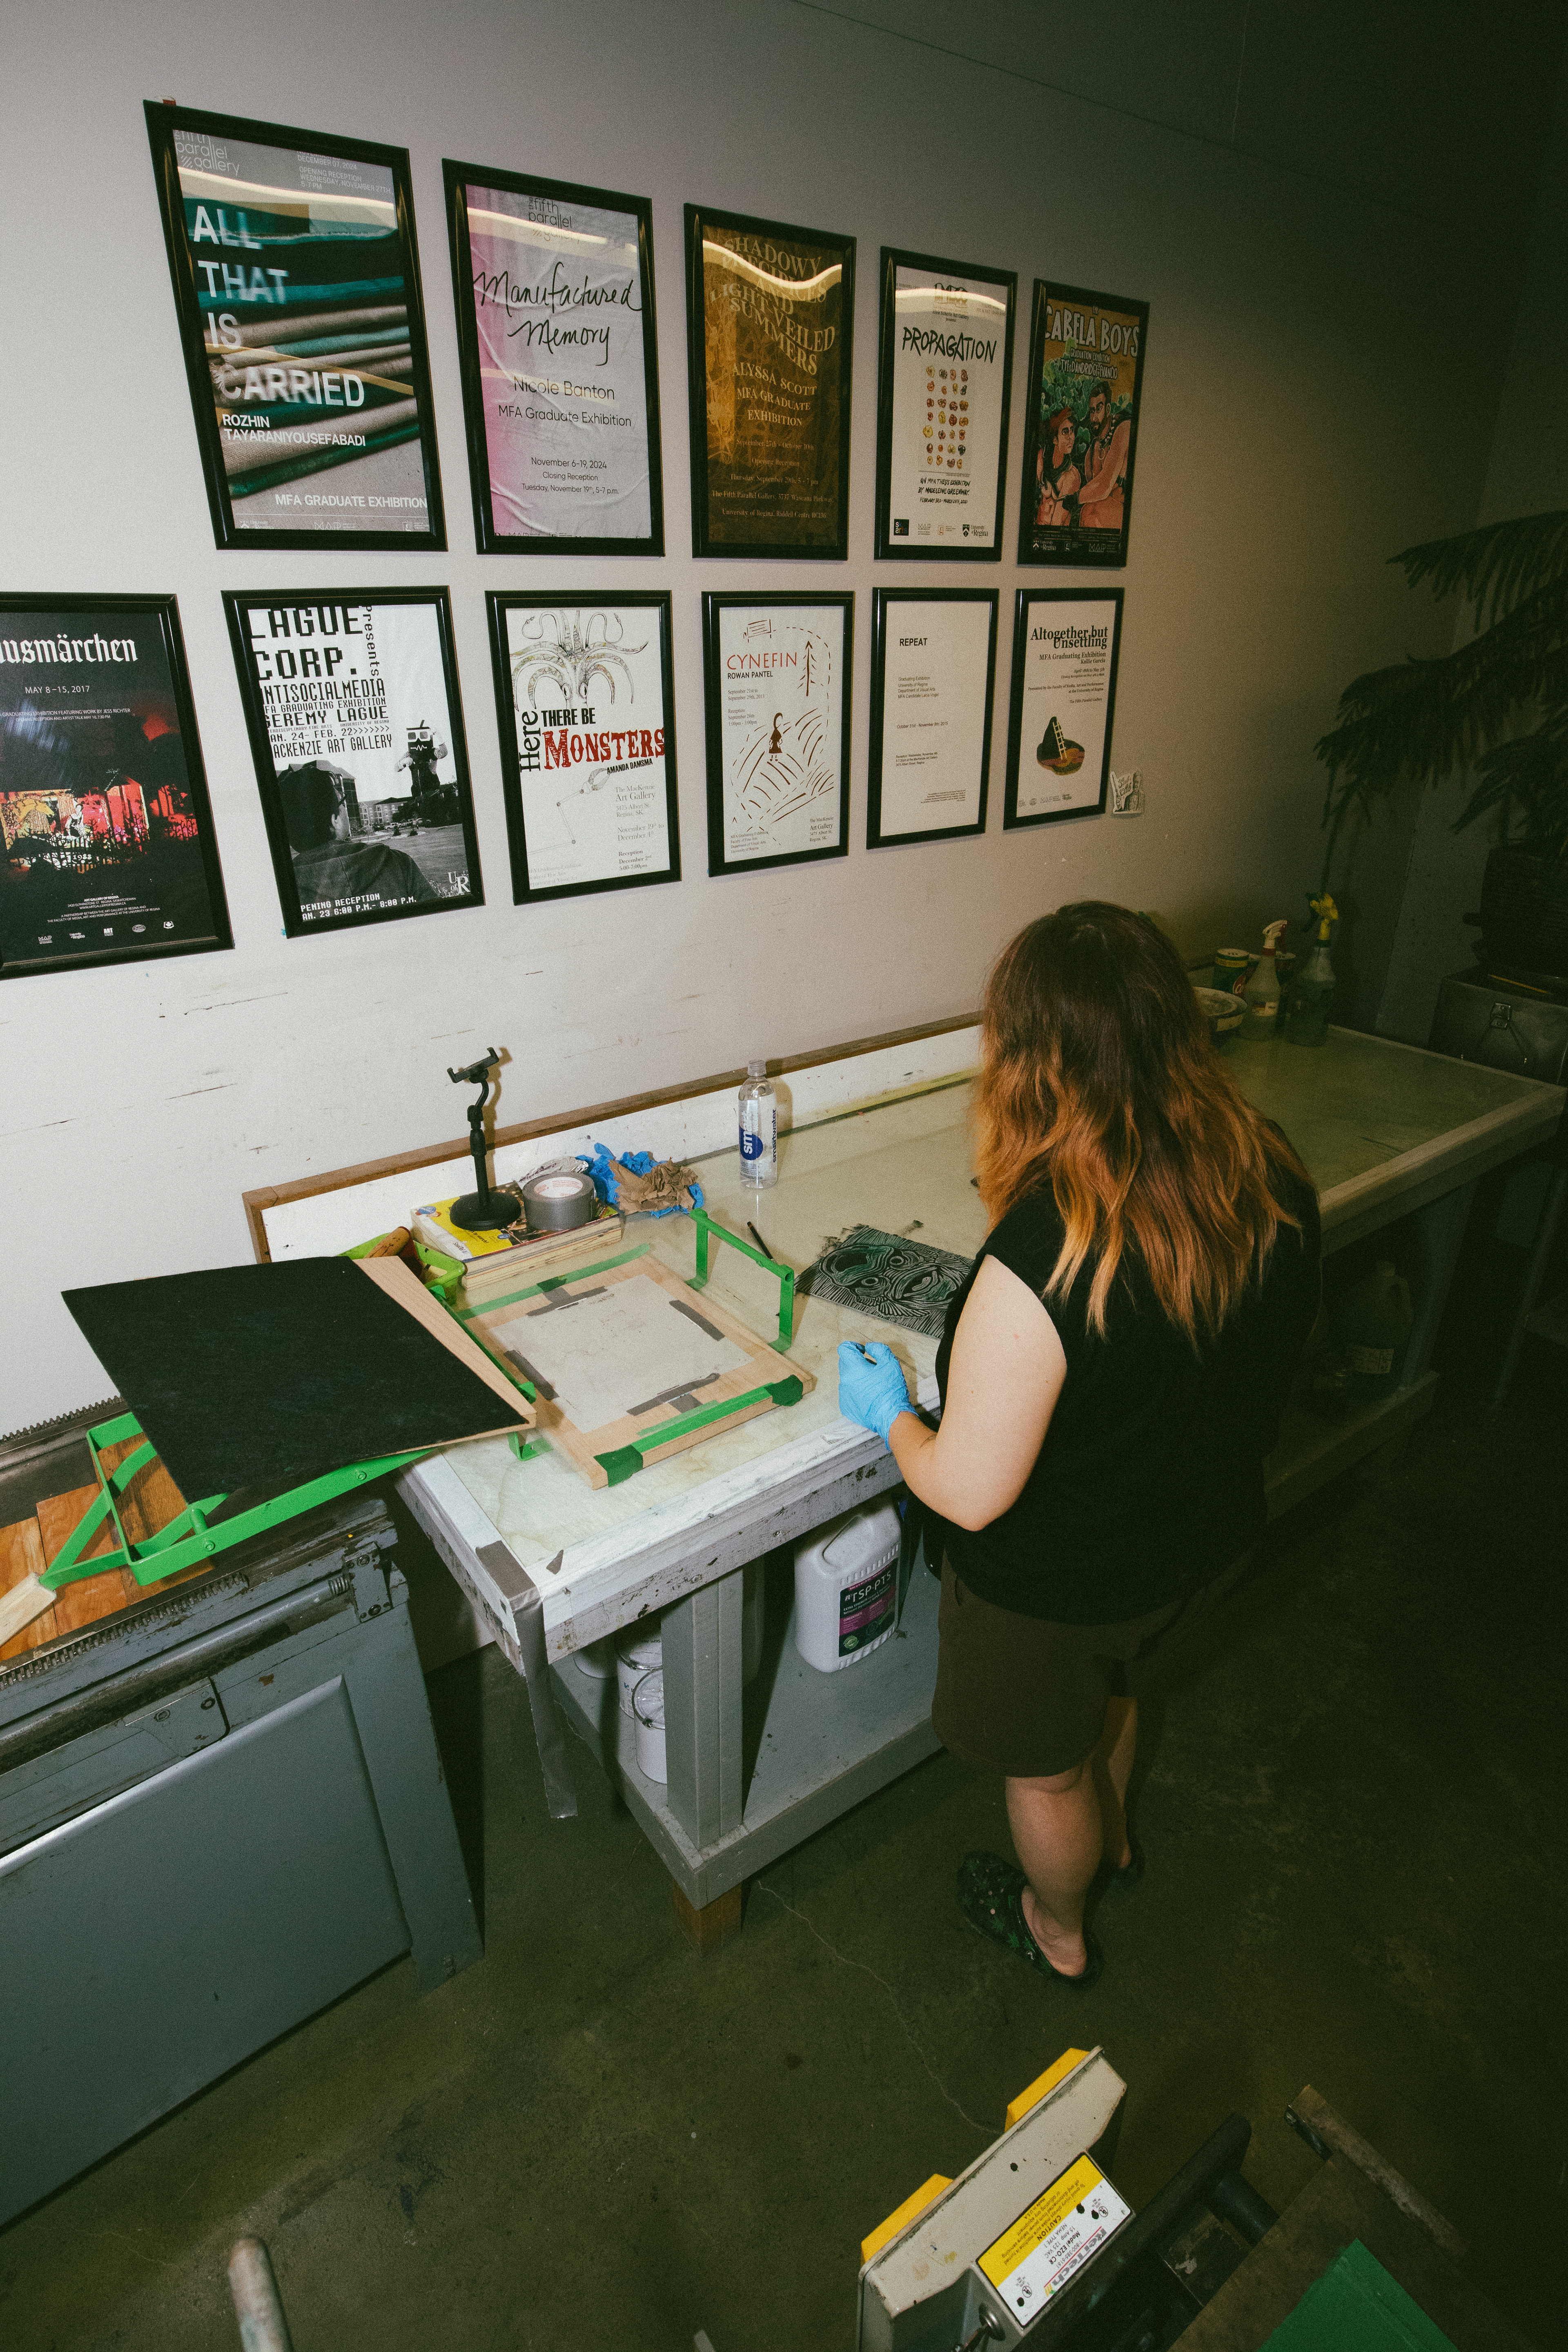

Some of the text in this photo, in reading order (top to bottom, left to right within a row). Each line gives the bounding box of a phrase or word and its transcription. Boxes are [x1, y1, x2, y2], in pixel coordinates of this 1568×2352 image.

[176, 142, 227, 159] parallel
[298, 155, 332, 166] DECEMBER
[299, 166, 362, 182] OPENING RECEPTION
[341, 180, 374, 191] NOVEMBER
[534, 198, 559, 213] fifth
[194, 205, 263, 249] ALL
[528, 212, 572, 228] parallel
[724, 237, 822, 278] SHADOWY
[198, 261, 288, 304] THAT
[474, 261, 642, 317] Manufactured
[710, 283, 835, 352] LIGHT VEILED
[208, 312, 241, 350] IS
[730, 298, 817, 375] SUMMERS
[1100, 318, 1139, 358] BOYS
[507, 319, 610, 366] Memory
[902, 326, 997, 363] PROPAGATION
[1070, 348, 1091, 360] GRADUATION
[218, 364, 365, 407] CARRIED
[514, 376, 615, 400] Nicole Banton
[732, 362, 817, 395] ALYSSA SCOTT
[737, 387, 811, 410] MFA GRADUATE
[223, 414, 270, 428] ROZHIN
[499, 405, 631, 427] MFA Graduate Exhibition
[748, 410, 802, 426] EXHIBITION
[224, 428, 365, 447] TAYARANIYOUSEFABADI
[736, 439, 764, 448] September
[531, 457, 607, 469] November 2024
[543, 472, 598, 482] Closing Reception
[522, 483, 549, 492] Tuesday,
[550, 485, 581, 493] November
[275, 494, 428, 509] MFA GRADUATE EXHIBITION
[722, 508, 748, 517] University
[359, 606, 380, 677] presents
[900, 638, 928, 646] REPEAT
[1030, 625, 1108, 641] Altogether but
[1053, 635, 1107, 650] Unsettling
[0, 633, 138, 664] usmärchen
[253, 647, 357, 680] CORP.
[727, 652, 797, 670] CYNEFIN
[263, 678, 385, 704] NTISOCIALMEDIA
[281, 697, 386, 713] GRADUATING EXHIBITION
[337, 706, 388, 722] LAGUE
[541, 708, 596, 727] THERE BE
[314, 730, 336, 738] FEB.
[519, 710, 541, 772] Here
[273, 734, 392, 758] ACKENZIE ART GALLERY
[607, 758, 653, 774] AMANDA DAMSMA
[615, 792, 656, 802] Art Gallery
[618, 825, 646, 833] November
[448, 872, 457, 884] U
[457, 876, 470, 894] R
[301, 893, 380, 912] PENING RECEPTION
[320, 896, 416, 918] 23 6:00 8:00 P.M.
[741, 1111, 753, 1154] smart
[1036, 2214, 1062, 2241] CAUTION
[1046, 2223, 1067, 2245] NEMA TYPE
[1044, 2230, 1070, 2258] Amp 125 VAC
[1048, 2230, 1080, 2265] Model EZO-CR
